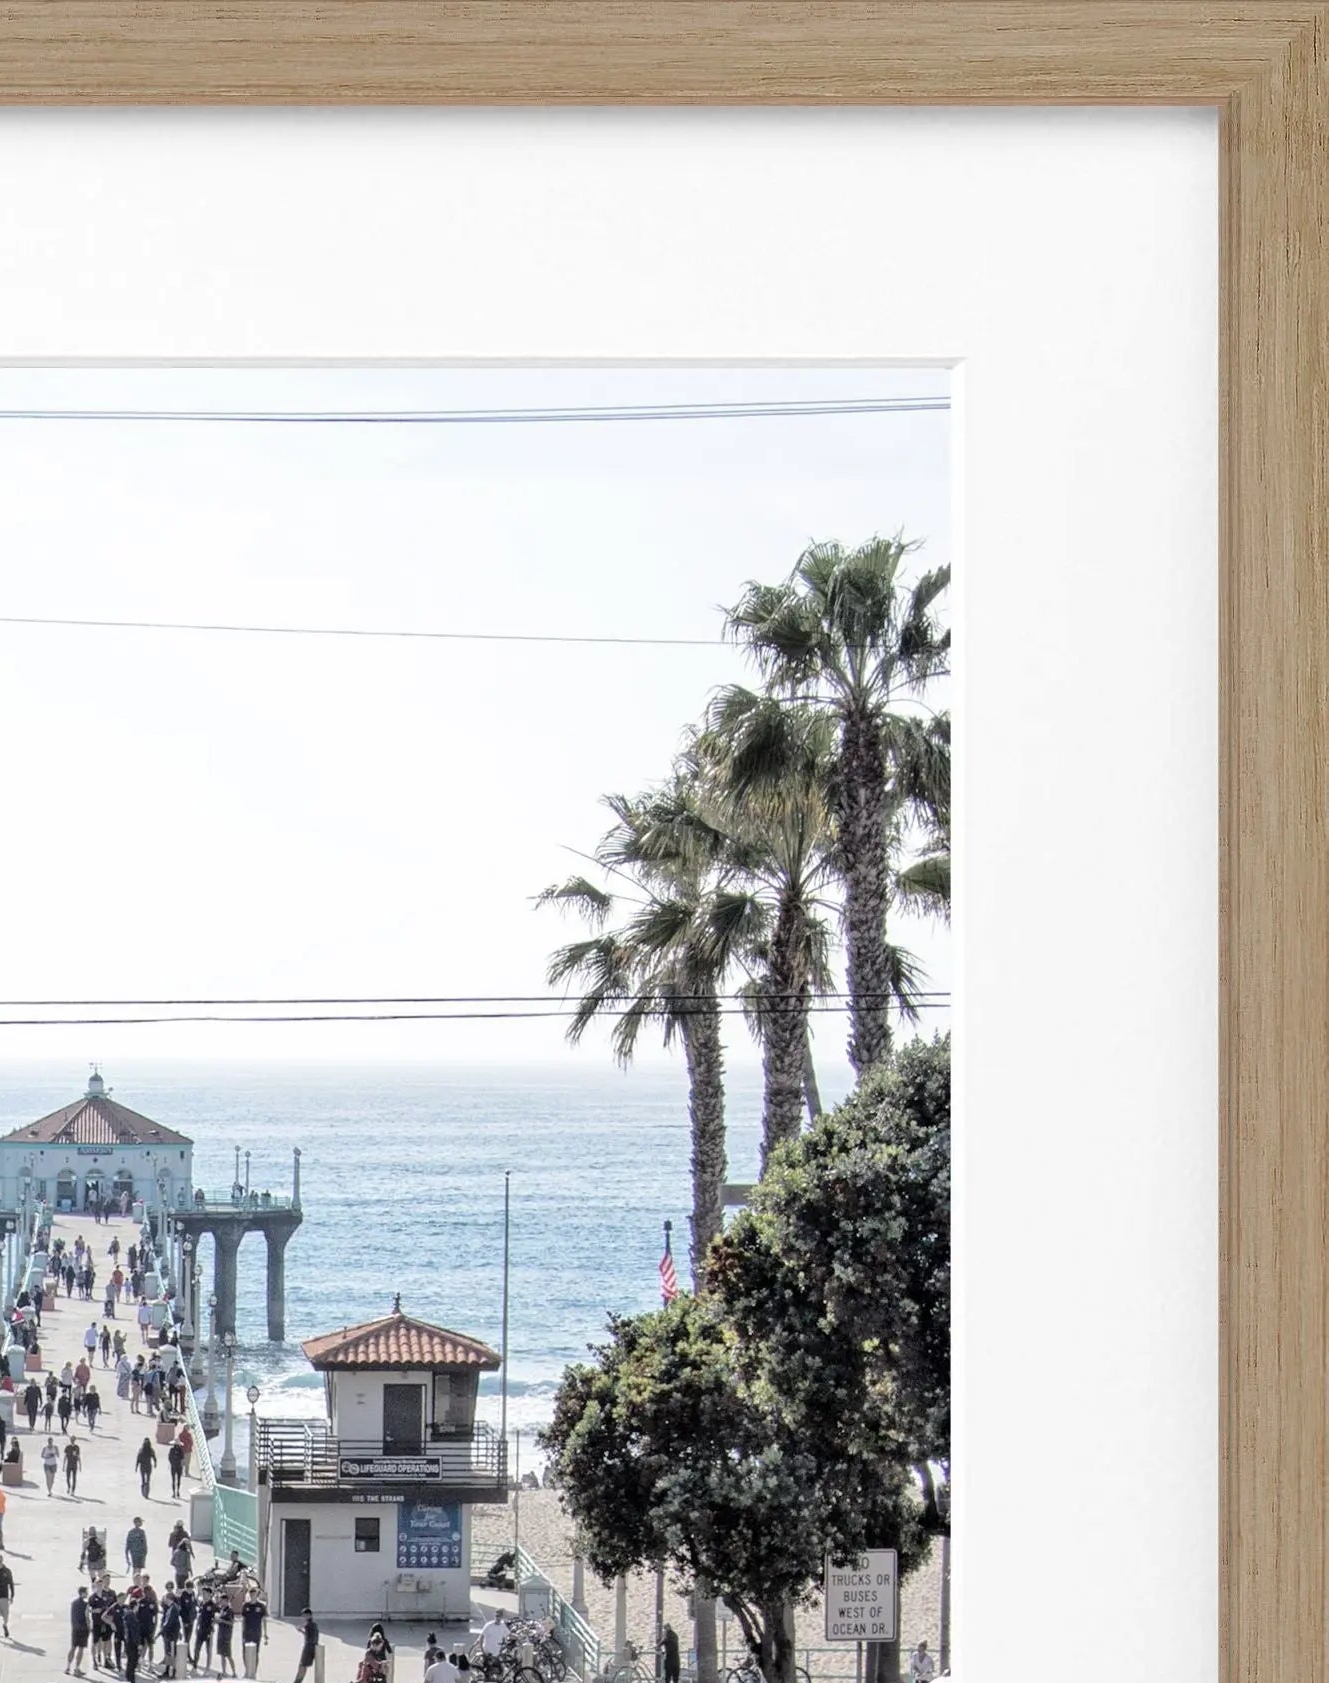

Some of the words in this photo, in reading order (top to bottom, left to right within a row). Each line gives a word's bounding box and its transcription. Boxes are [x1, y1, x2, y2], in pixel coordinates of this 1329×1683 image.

[360, 1463, 396, 1473] LIFEGUARD
[398, 1463, 439, 1473] OPERATIONS
[831, 1574, 871, 1586] TRUCKS
[876, 1574, 890, 1585] OR
[843, 1590, 878, 1602] BUSES
[838, 1606, 865, 1618] WEST
[869, 1606, 883, 1618] OF
[832, 1623, 866, 1635] OCEAN
[871, 1622, 889, 1635] DR.
